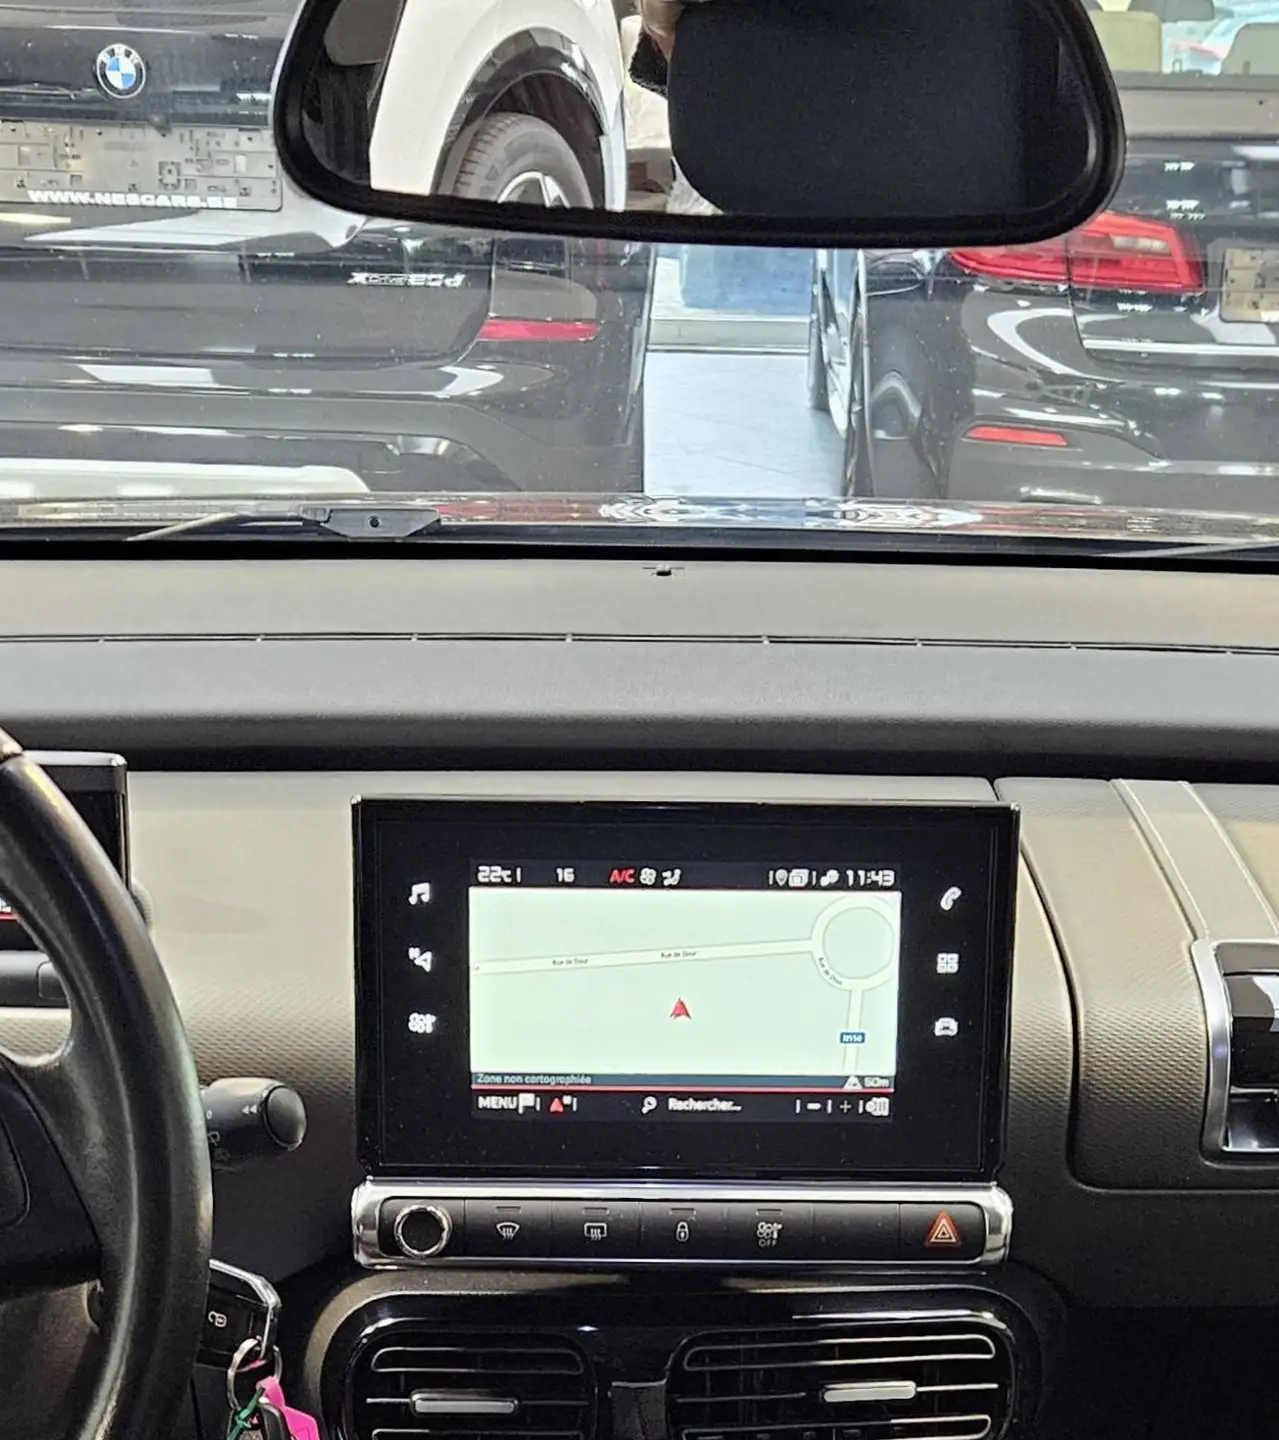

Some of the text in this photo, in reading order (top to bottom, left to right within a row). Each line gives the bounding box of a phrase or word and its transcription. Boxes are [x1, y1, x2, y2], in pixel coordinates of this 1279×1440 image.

[556, 868, 575, 882] 16
[610, 869, 635, 883] A/C
[846, 869, 895, 887] 11:43
[477, 1073, 592, 1087] Zone non cartographiée
[477, 1096, 518, 1109] MENU
